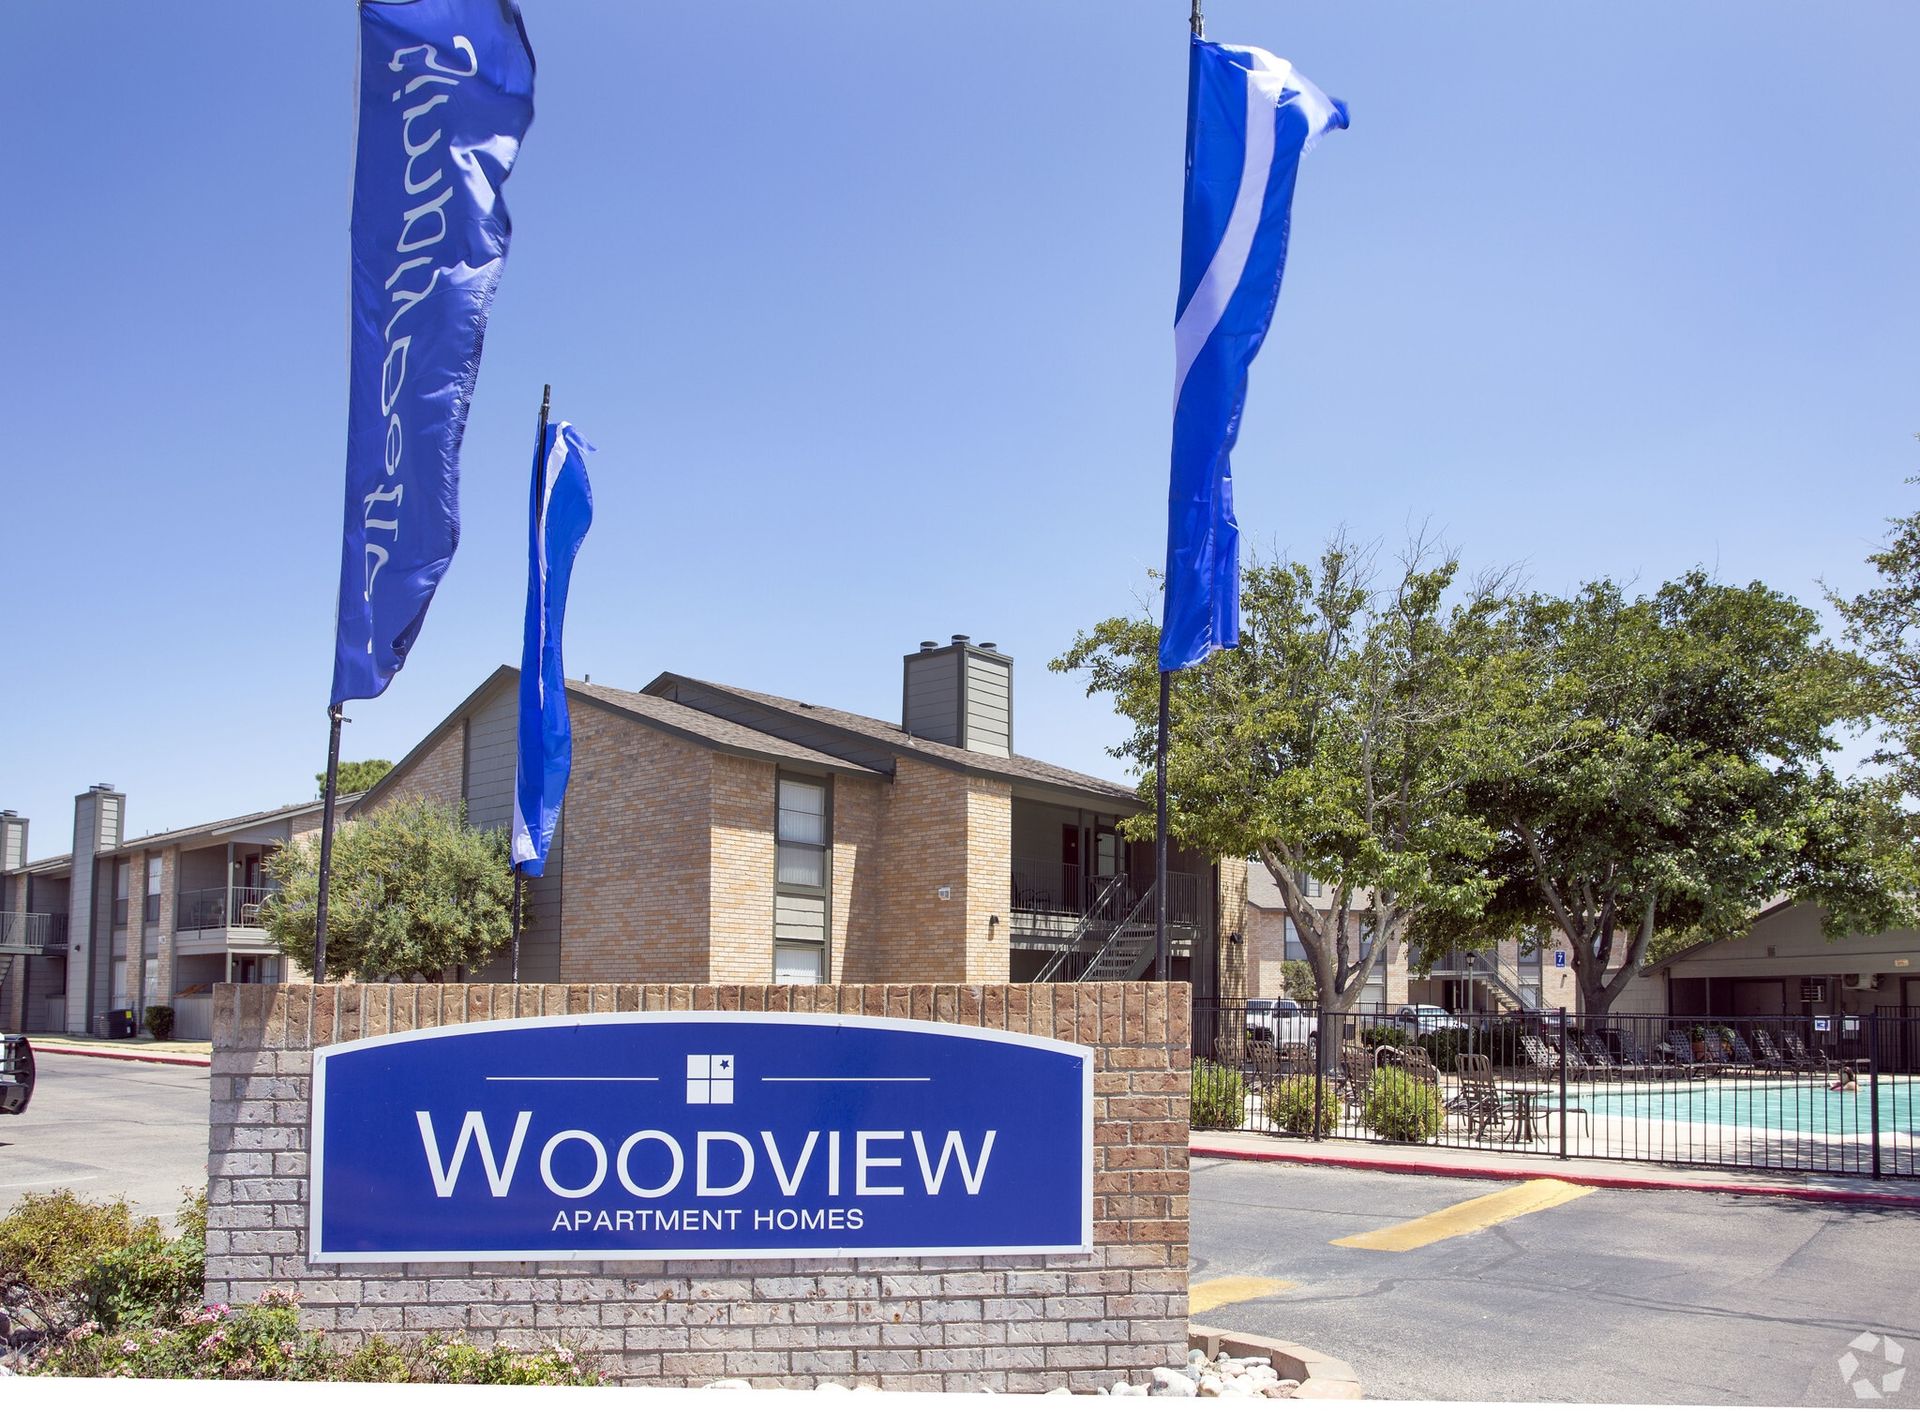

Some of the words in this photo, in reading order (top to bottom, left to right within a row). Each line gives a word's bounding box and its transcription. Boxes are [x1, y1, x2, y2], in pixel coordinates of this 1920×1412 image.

[415, 1110, 997, 1199] WOODVIEW
[551, 1209, 742, 1232] APARTMENT
[753, 1208, 864, 1231] HOMES
